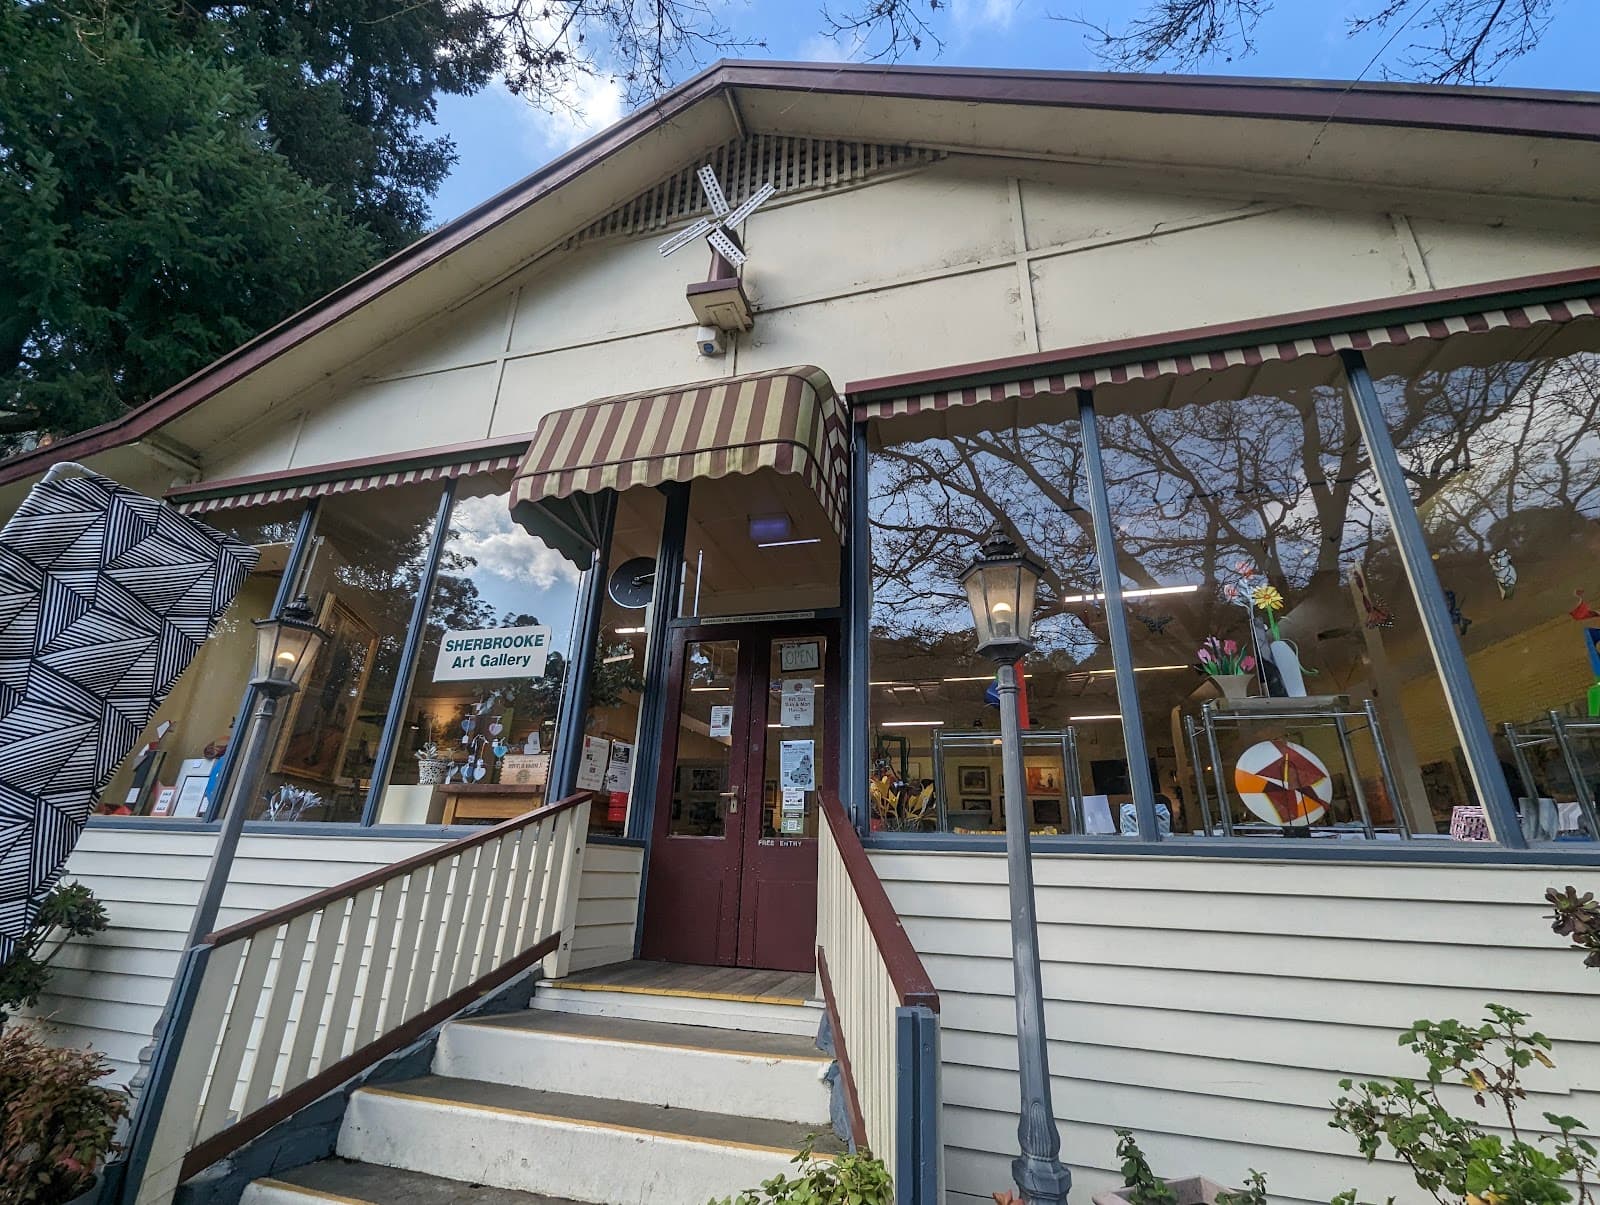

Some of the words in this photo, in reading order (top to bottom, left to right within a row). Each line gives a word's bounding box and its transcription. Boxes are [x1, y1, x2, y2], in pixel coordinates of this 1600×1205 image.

[445, 634, 545, 652] SHERBROOKE
[452, 655, 476, 669] Art
[480, 653, 532, 668] Gallery
[785, 648, 814, 665] OPEN
[758, 839, 775, 847] FREE
